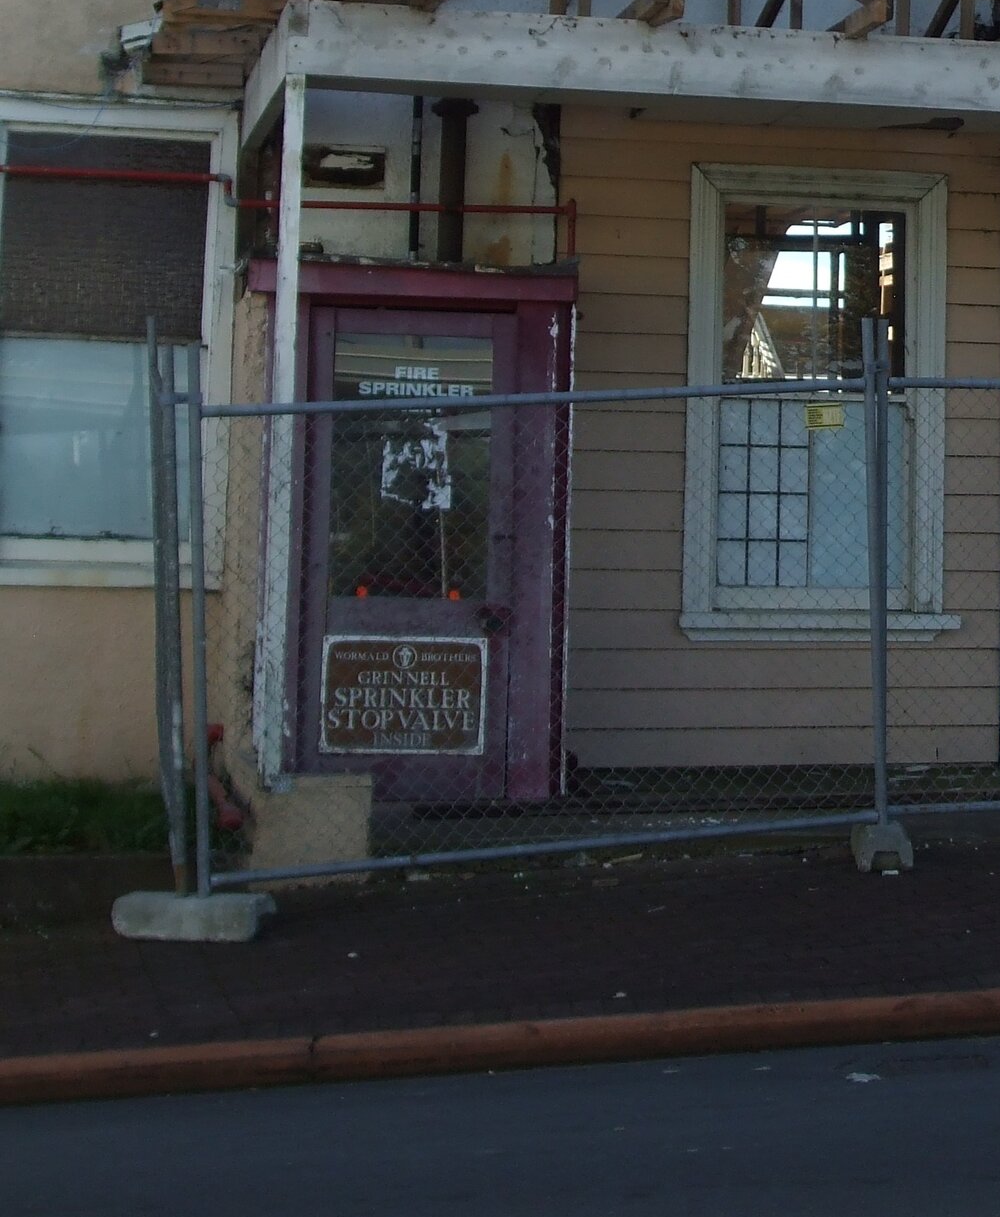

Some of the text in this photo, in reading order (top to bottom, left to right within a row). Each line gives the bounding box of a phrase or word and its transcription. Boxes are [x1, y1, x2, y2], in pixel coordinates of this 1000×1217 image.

[394, 366, 440, 380] FIRE
[358, 381, 474, 397] SPRINKLER
[335, 651, 478, 663] WORMALD BROTHERS
[357, 671, 449, 686] GRINNELL
[334, 687, 471, 709] SPRINKLER
[327, 708, 476, 731] STOP VALVE
[373, 732, 432, 746] INSIDE
